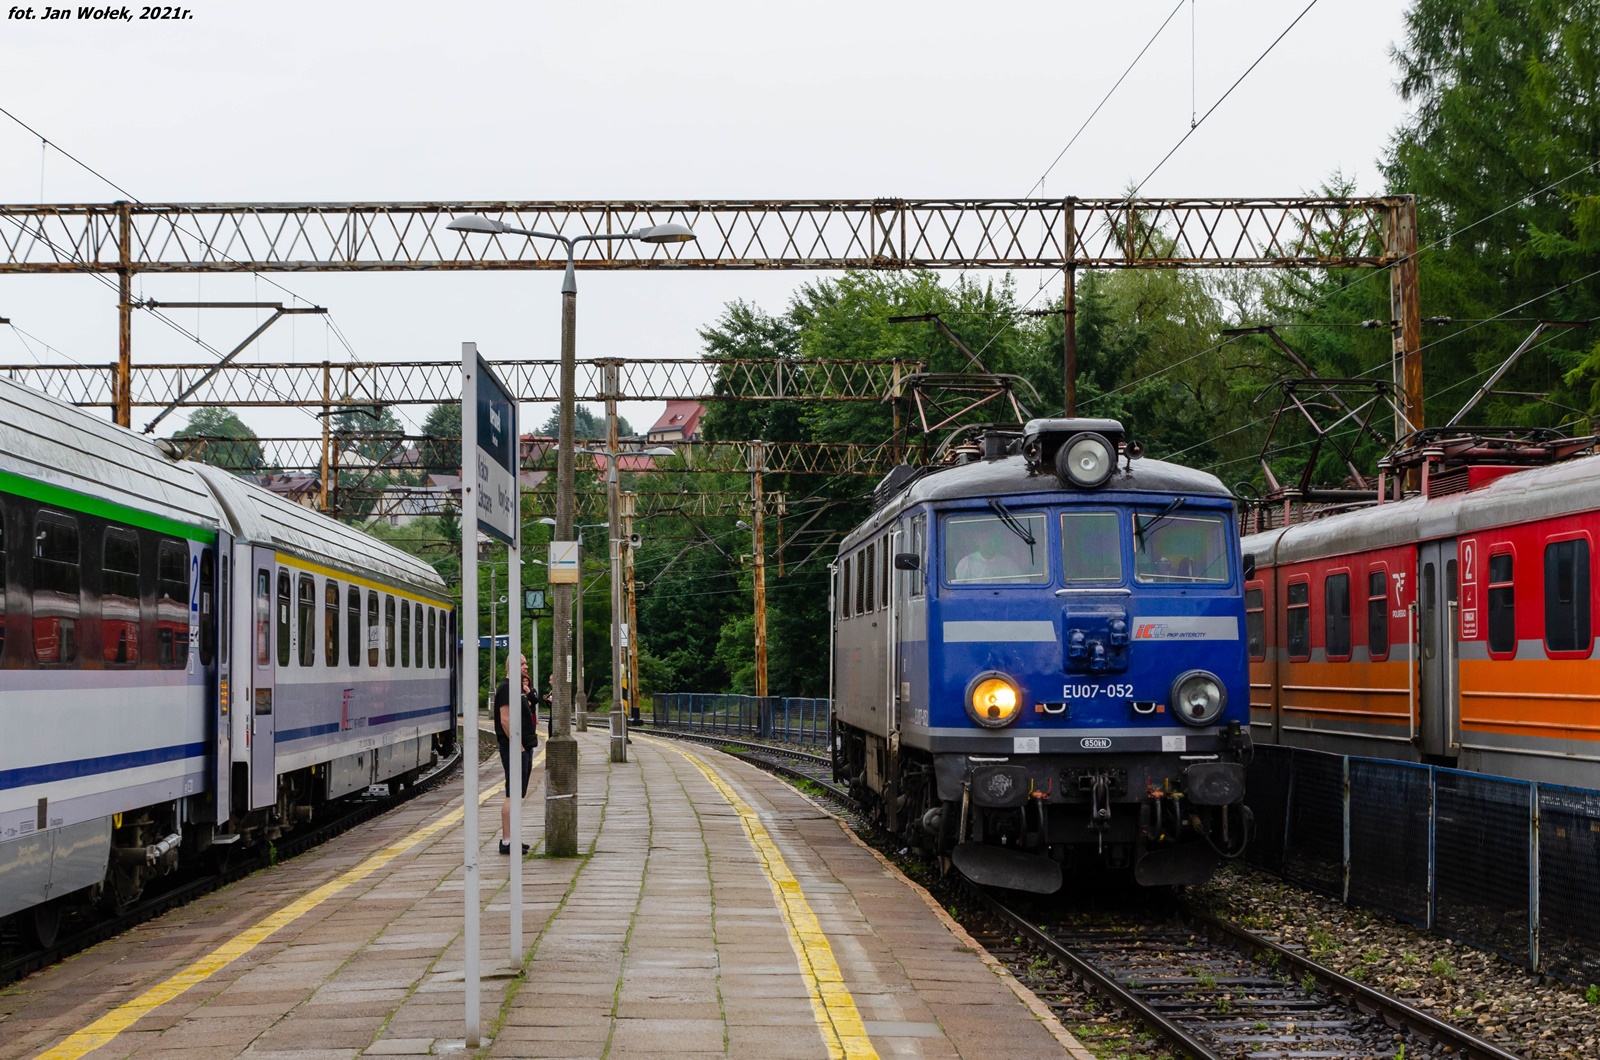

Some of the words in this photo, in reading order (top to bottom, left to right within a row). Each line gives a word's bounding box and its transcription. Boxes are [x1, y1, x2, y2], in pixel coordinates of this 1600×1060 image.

[1465, 545, 1472, 580] 2
[191, 555, 199, 612] 2
[1063, 684, 1134, 698] EU07-052
[1084, 739, 1107, 747] 850kN
